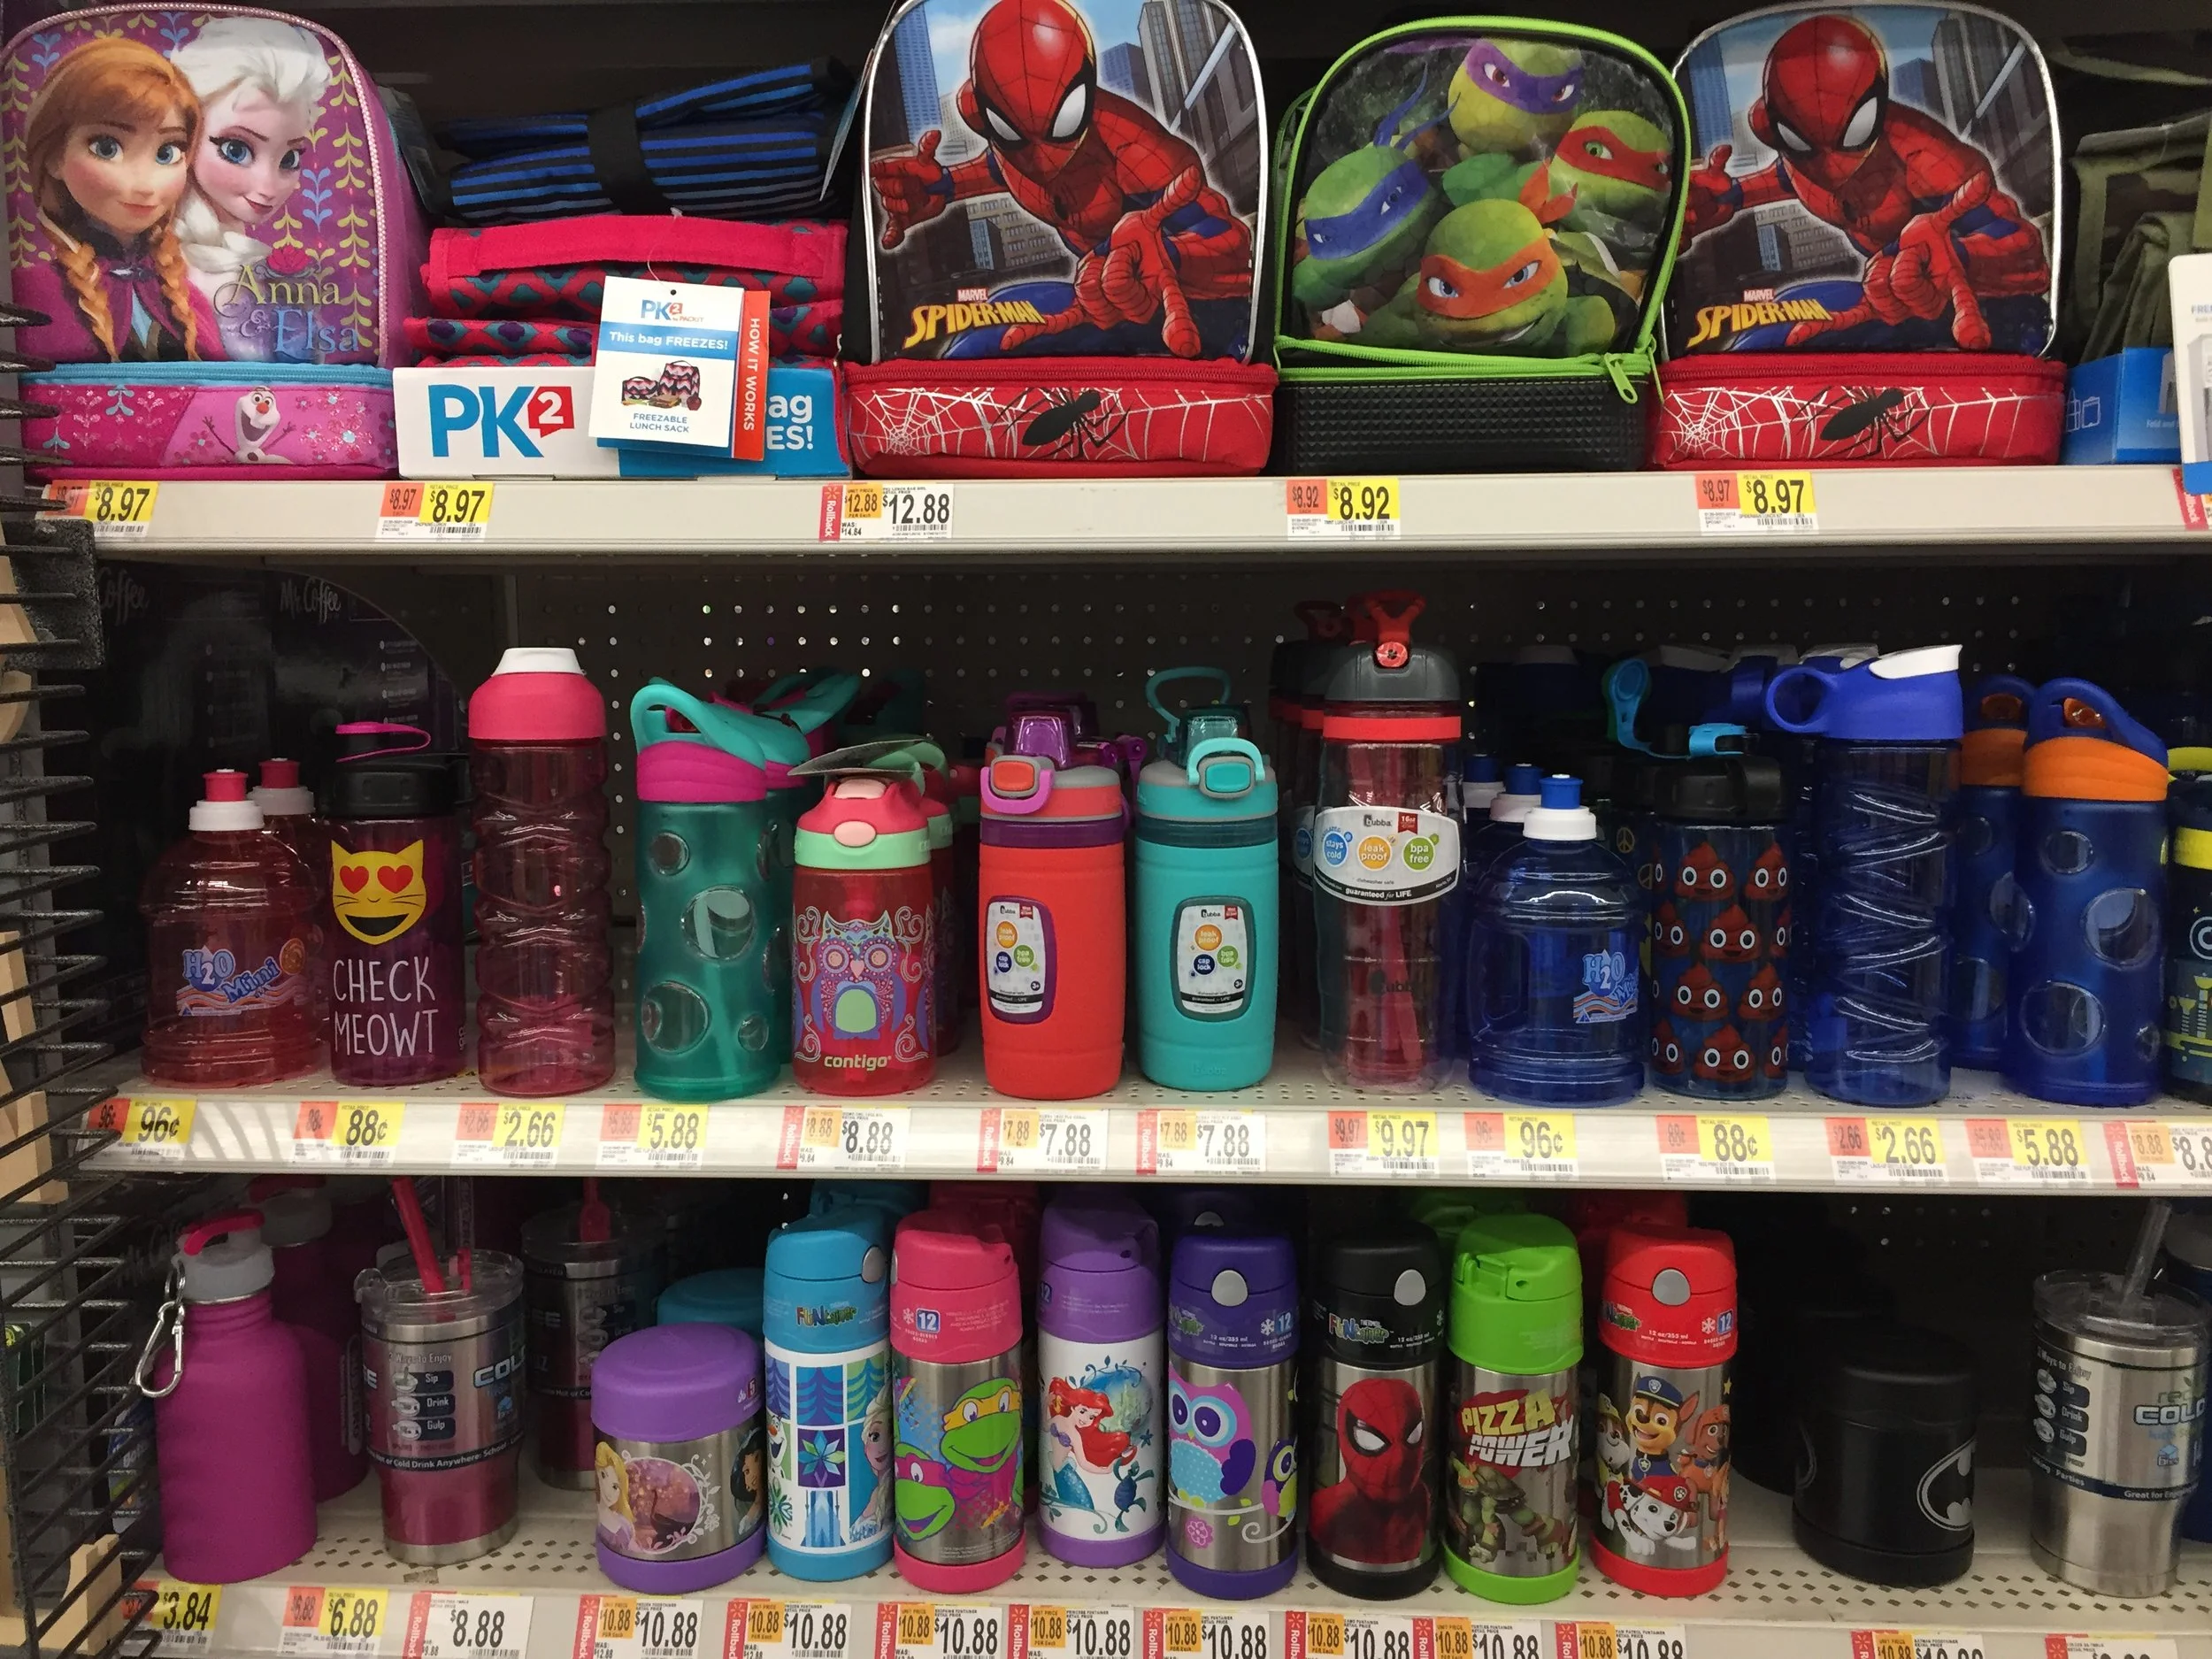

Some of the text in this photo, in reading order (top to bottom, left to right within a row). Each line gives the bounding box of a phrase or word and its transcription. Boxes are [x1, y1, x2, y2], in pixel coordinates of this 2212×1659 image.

[214, 265, 341, 318] Anna
[957, 288, 988, 302] MARVEL
[1744, 288, 1774, 302] MARVEL
[241, 307, 359, 354] & Elsa
[610, 332, 729, 350] This bag FREEZES!
[743, 319, 760, 431] HOW IT WORKS
[630, 422, 689, 433] LUNCH SACK
[633, 412, 687, 424] FREEZABLE
[389, 488, 417, 511] $8.97
[844, 494, 878, 512] $12.88
[1293, 486, 1318, 509] $8.92
[1333, 486, 1390, 520] $8.92
[1703, 480, 1730, 503] $8.97
[1747, 479, 1804, 514] $8.97
[95, 487, 150, 522] $8.97
[430, 488, 485, 523] $8.97
[883, 494, 950, 524] $12.88
[825, 500, 837, 537] Rollback
[280, 576, 342, 625] Mr. Coffee
[1326, 840, 1343, 850] stays
[1364, 843, 1384, 853] leak
[1410, 844, 1428, 854] bpa
[1362, 851, 1387, 864] proof
[1409, 854, 1429, 864] free
[1346, 887, 1385, 898] guaranteed
[224, 956, 280, 1003] Mini
[334, 956, 434, 1003] CHECK
[334, 1010, 439, 1057] MEOWT
[824, 1054, 887, 1071] contigo
[139, 1106, 180, 1142] 96¢
[346, 1110, 388, 1146] 88¢
[503, 1110, 556, 1148] $2.66
[647, 1112, 699, 1149] $5.88
[806, 1118, 833, 1138] $8.88
[1003, 1120, 1030, 1141] $7.88
[1160, 1122, 1187, 1141] $7.88
[1335, 1118, 1360, 1142] $9.97
[783, 1123, 795, 1164] Rollback
[842, 1120, 893, 1155] $8.88
[982, 1125, 995, 1166] Rollback
[1040, 1123, 1091, 1157] $7.88
[1140, 1128, 1151, 1170] Rollback
[1197, 1124, 1249, 1157] $7.88
[1375, 1119, 1429, 1156] $9.97
[1520, 1121, 1563, 1158] 96¢
[1713, 1124, 1758, 1162] 88¢
[1833, 1125, 1863, 1149] $2.66
[1876, 1125, 1936, 1165] $2.66
[2016, 1128, 2078, 1167] $5.88
[2114, 1141, 2131, 1182] Rollback
[918, 1311, 936, 1331] 12
[1278, 1312, 1292, 1330] 12
[1720, 1312, 1732, 1331] 12
[428, 1351, 451, 1363] Enjoy
[2059, 1360, 2066, 1369] to
[425, 1373, 438, 1383] Sip
[749, 1379, 757, 1394] 5
[2062, 1381, 2074, 1394] Sip
[426, 1397, 449, 1407] Drink
[427, 1421, 445, 1431] Gulp
[1462, 1393, 1555, 1436] PIZZA
[2062, 1407, 2083, 1422] Drink
[1468, 1415, 1574, 1467] POWER
[2059, 1429, 2076, 1444] Gulp
[394, 1459, 411, 1469] Cold
[436, 1453, 481, 1468] Anywhere:
[483, 1443, 507, 1457] School
[2055, 1470, 2085, 1486] Parties
[2124, 1490, 2149, 1499] Great
[163, 1591, 212, 1631] $3.84
[328, 1598, 378, 1638] $6.88
[599, 1609, 631, 1632] $10.88
[748, 1611, 780, 1633] $10.88
[450, 1609, 504, 1647] $8.88
[578, 1616, 592, 1659] Rollback
[635, 1611, 697, 1647] $10.88
[783, 1613, 847, 1650] $10.88
[899, 1615, 930, 1638] $10.88
[934, 1617, 998, 1655] $10.88
[1030, 1617, 1062, 1639] $10.88
[1066, 1618, 1130, 1655] $10.88
[1165, 1623, 1197, 1646] $10.88
[1308, 1624, 1340, 1647] $10.88
[1202, 1624, 1266, 1659] $10.88
[1435, 1631, 1469, 1654] $10.88
[1579, 1635, 1613, 1659] $10.88
